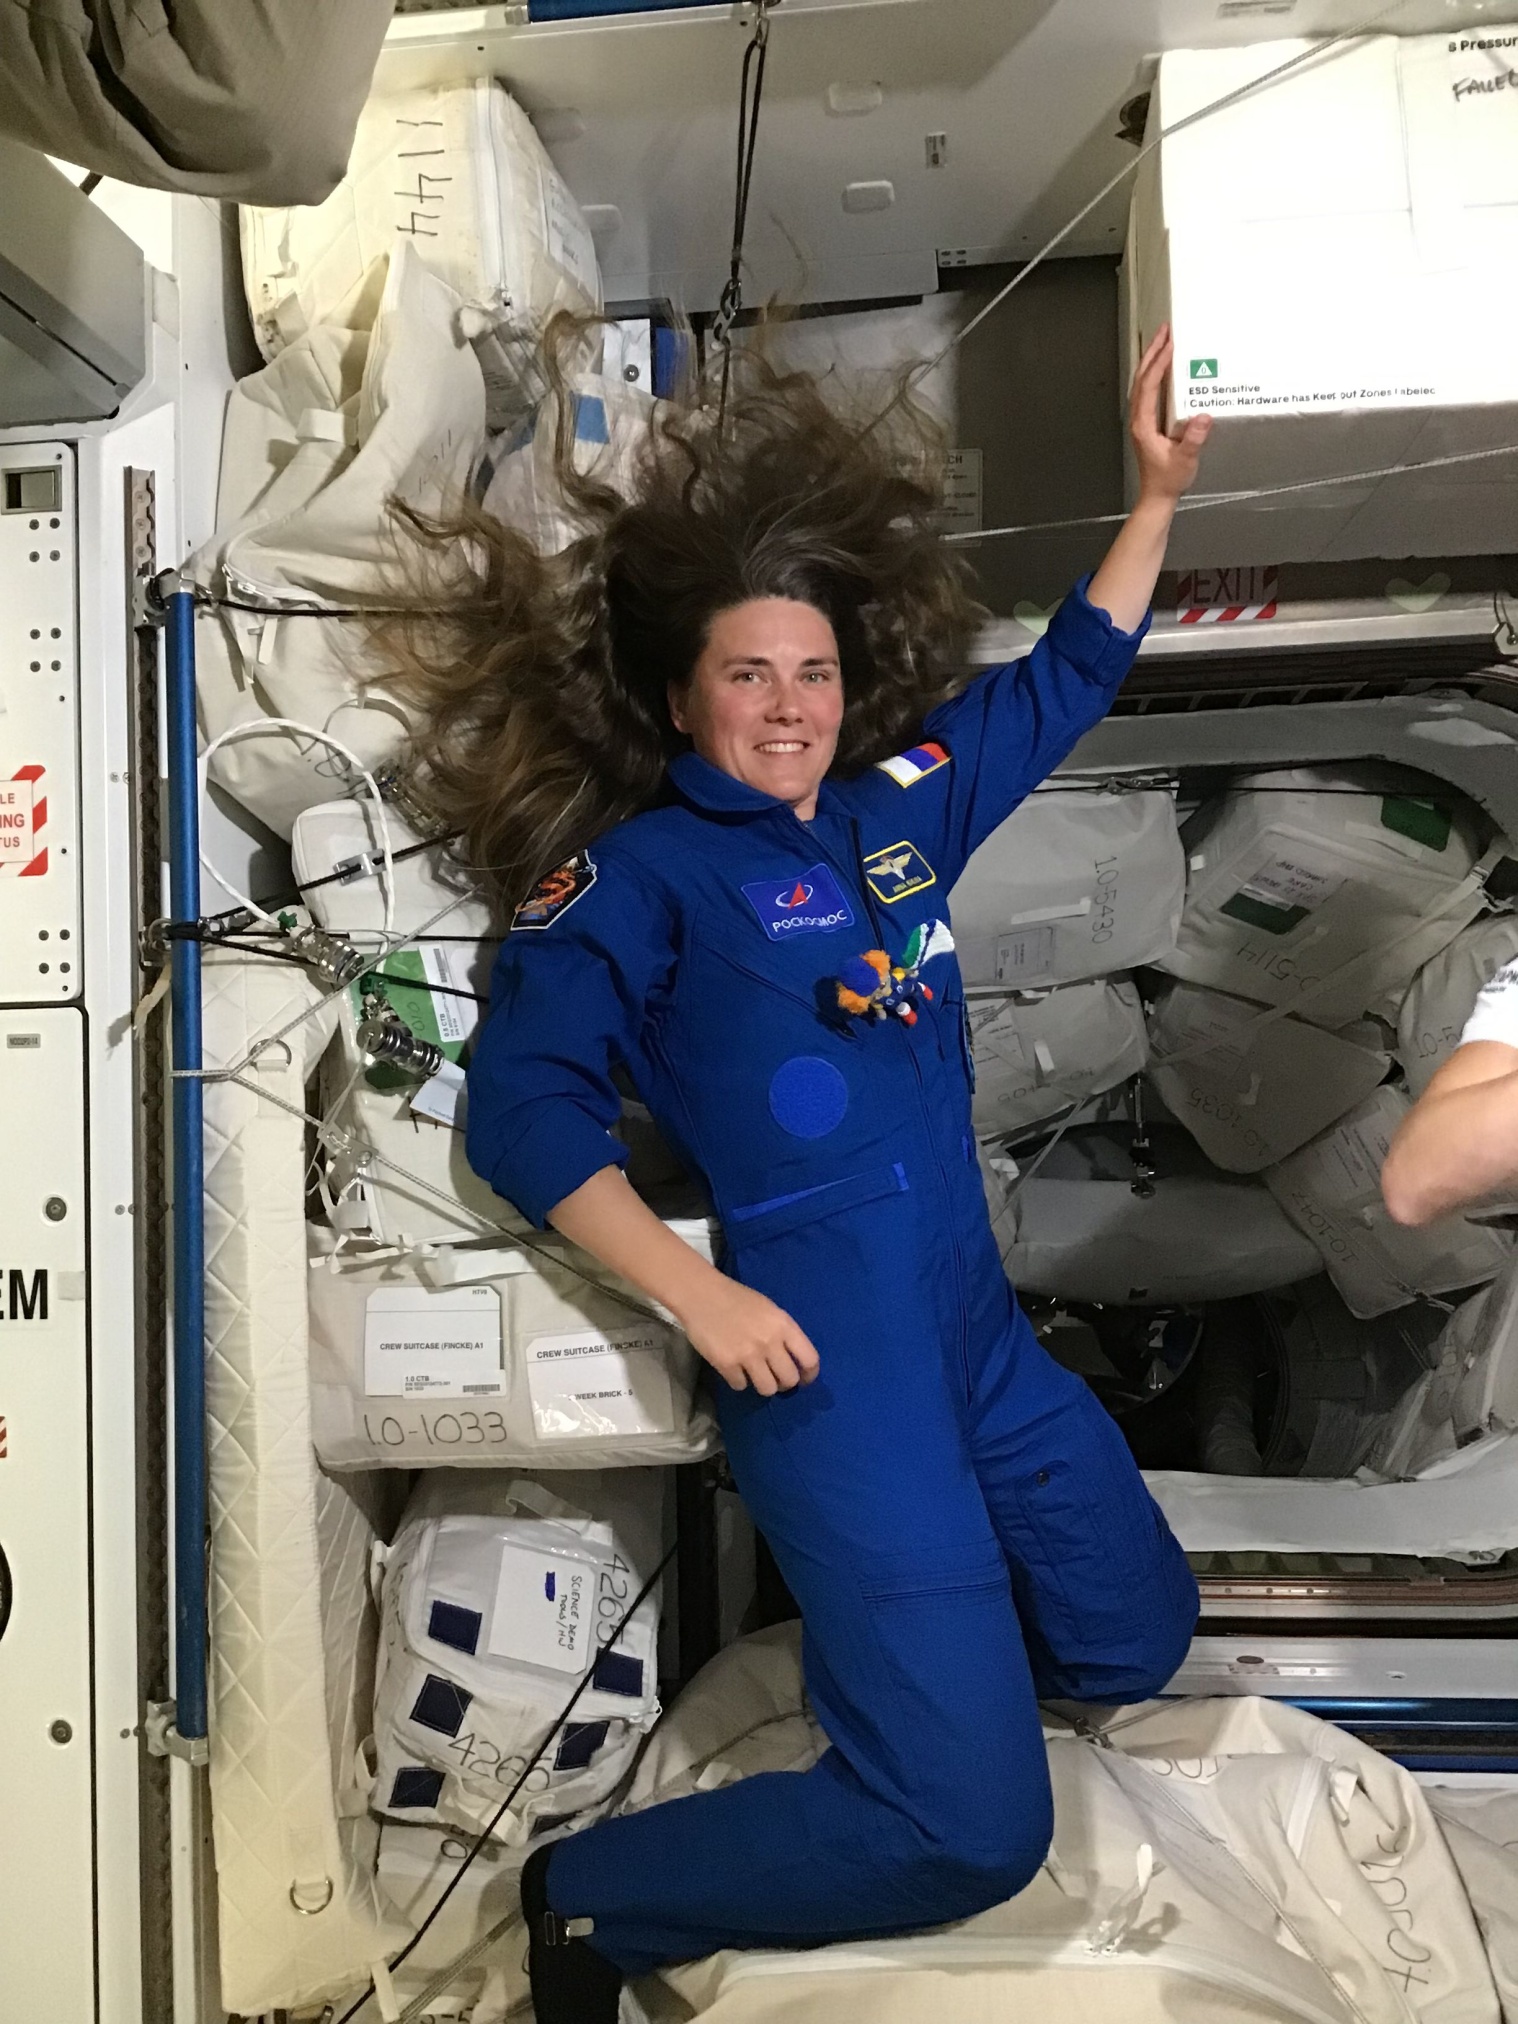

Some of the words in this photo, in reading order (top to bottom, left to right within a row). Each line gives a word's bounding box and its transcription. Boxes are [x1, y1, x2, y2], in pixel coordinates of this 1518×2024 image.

[1189, 386, 1209, 395] ESD
[1212, 384, 1260, 394] Sensitive
[1190, 397, 1235, 408] Caution:
[1237, 395, 1289, 406] Hardware
[1292, 393, 1310, 402] has
[1359, 388, 1392, 398] Zones
[1091, 855, 1119, 944] 1.0-5430
[0, 1268, 48, 1320] M
[403, 1342, 440, 1350] SUITCASE
[441, 1342, 473, 1351] (FINCKE)
[536, 1349, 562, 1359] CREW
[563, 1344, 606, 1356] SUITCASE
[598, 1389, 622, 1398] BRICK
[363, 1411, 508, 1446] 1.0-1033
[570, 1575, 583, 1620] SCIENCE
[567, 1623, 577, 1651] DEMO
